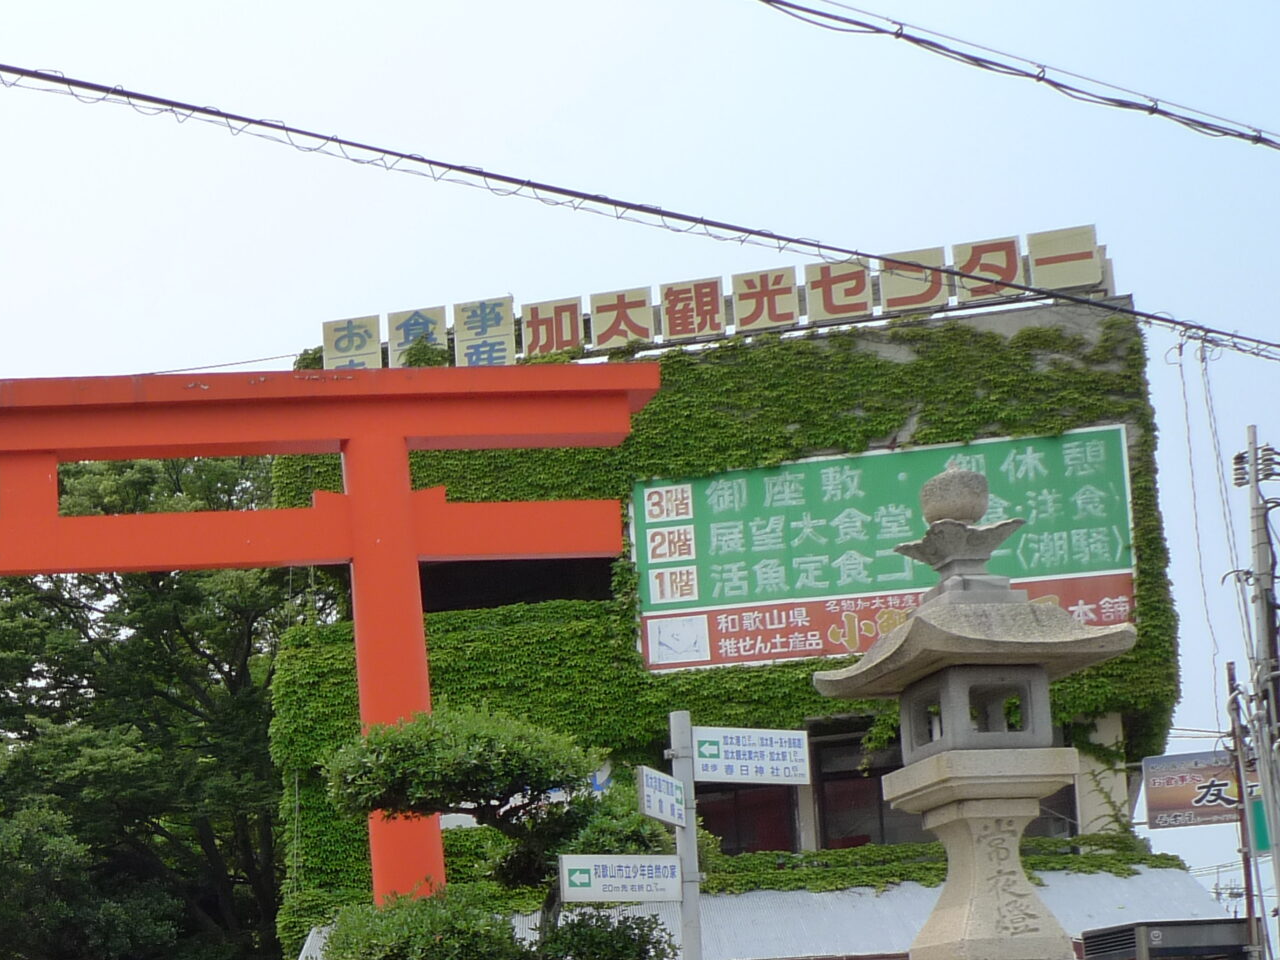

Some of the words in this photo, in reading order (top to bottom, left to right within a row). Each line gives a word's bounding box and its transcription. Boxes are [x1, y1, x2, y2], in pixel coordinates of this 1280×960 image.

[526, 240, 1094, 355] 加太観光センター
[645, 487, 690, 519] 3階
[649, 527, 694, 560] 2階
[654, 570, 696, 601] 1階
[717, 607, 812, 633] 和歌山県
[718, 631, 824, 657] 推せん土産品
